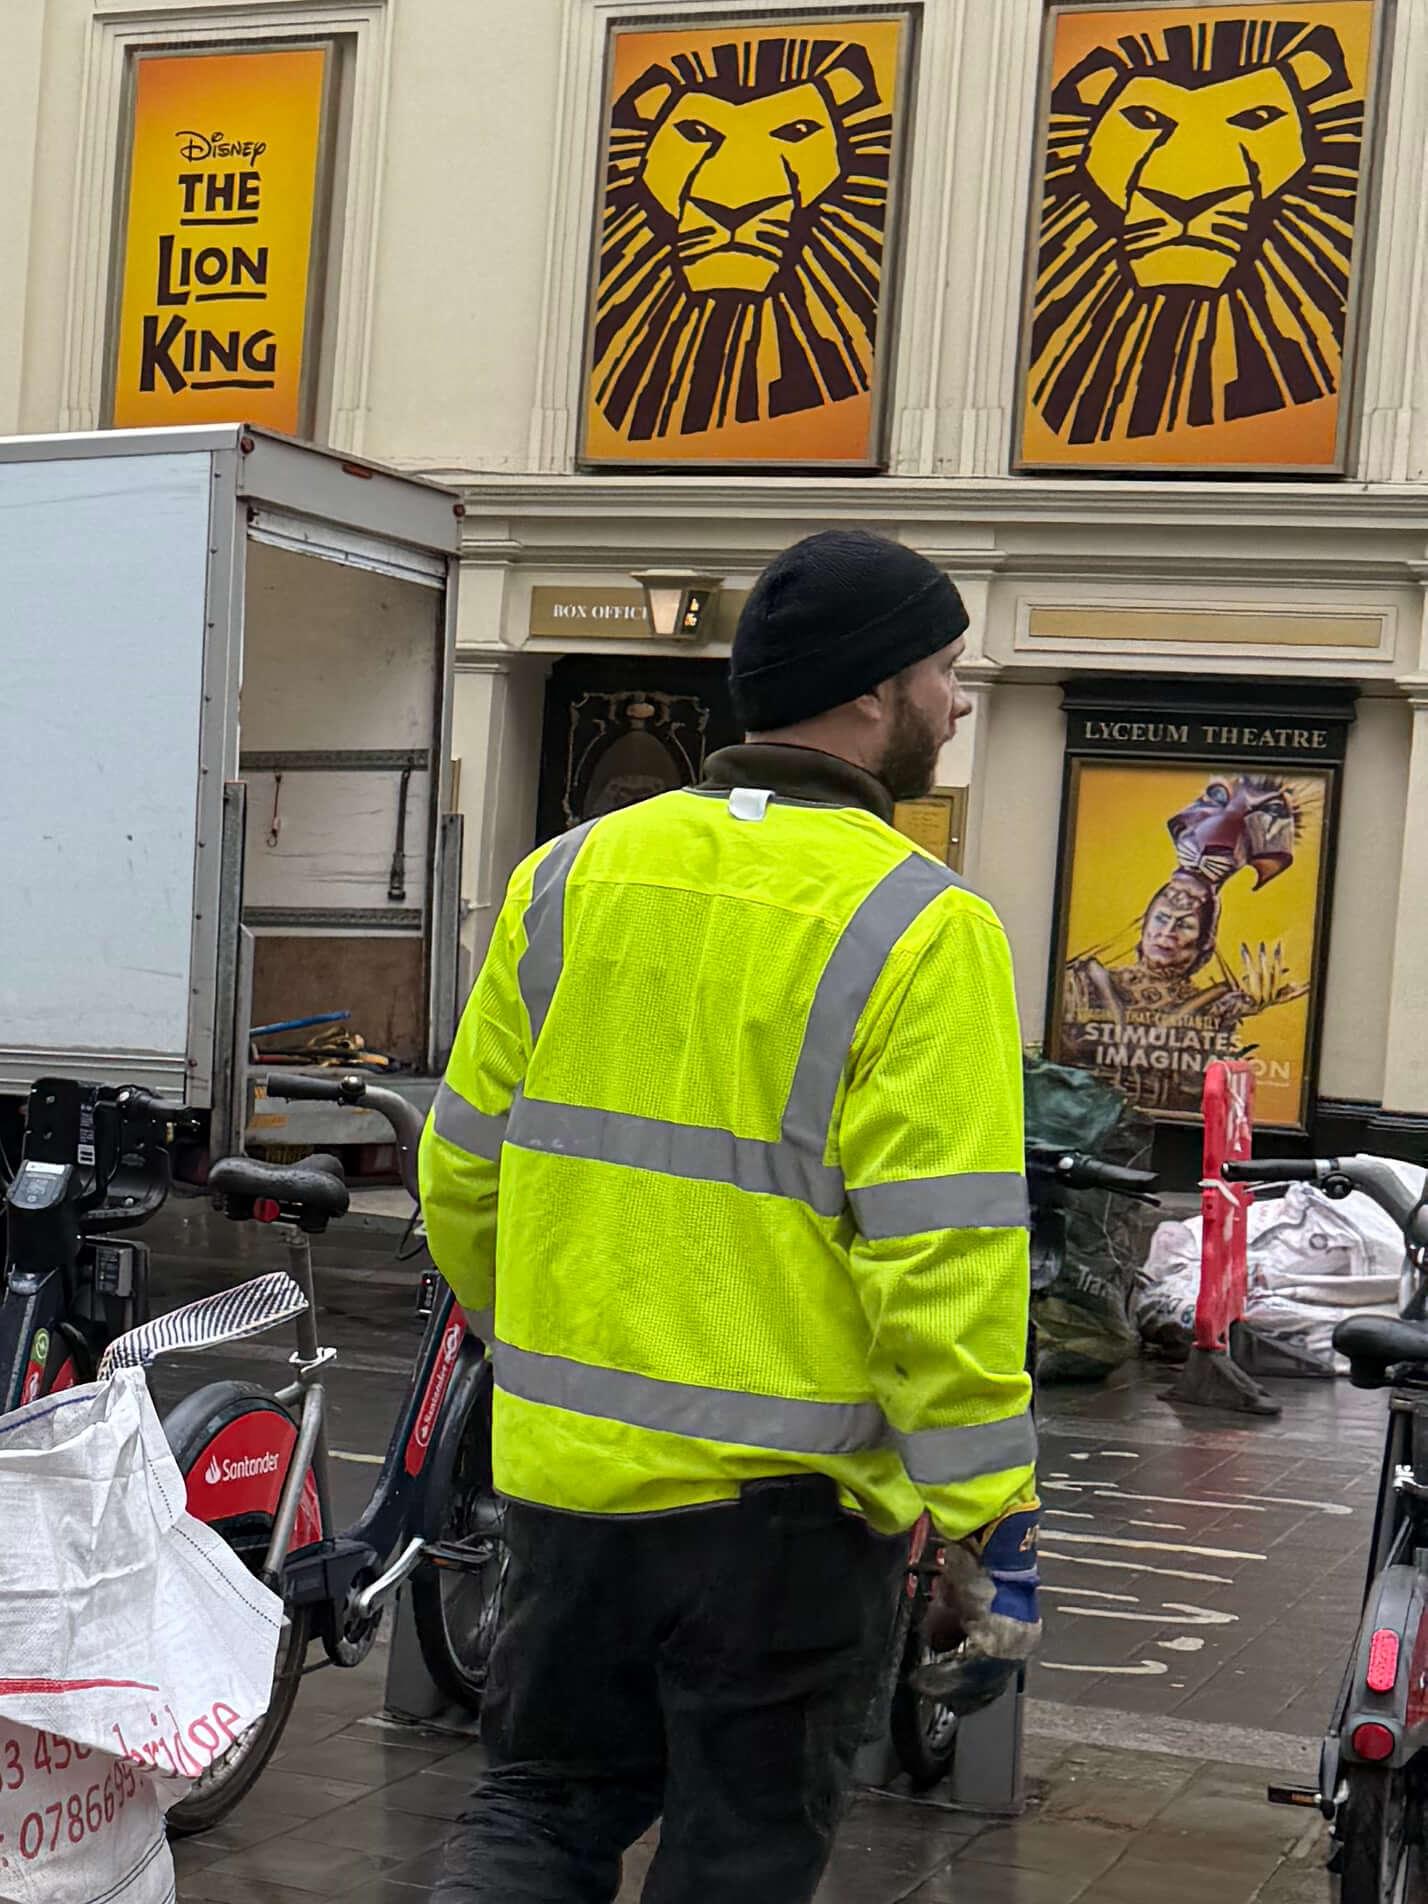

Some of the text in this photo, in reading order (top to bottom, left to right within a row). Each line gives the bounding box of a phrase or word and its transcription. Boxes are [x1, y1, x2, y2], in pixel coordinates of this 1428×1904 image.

[178, 170, 262, 214] THE
[156, 234, 270, 307] LION
[139, 313, 277, 395] KING
[552, 603, 588, 618] BOX
[1084, 721, 1328, 749] LYCEUM THEATRE
[1083, 1022, 1243, 1053] STIMULATES
[1095, 1045, 1291, 1081] IMAGINAON
[222, 1450, 280, 1482] Santander
